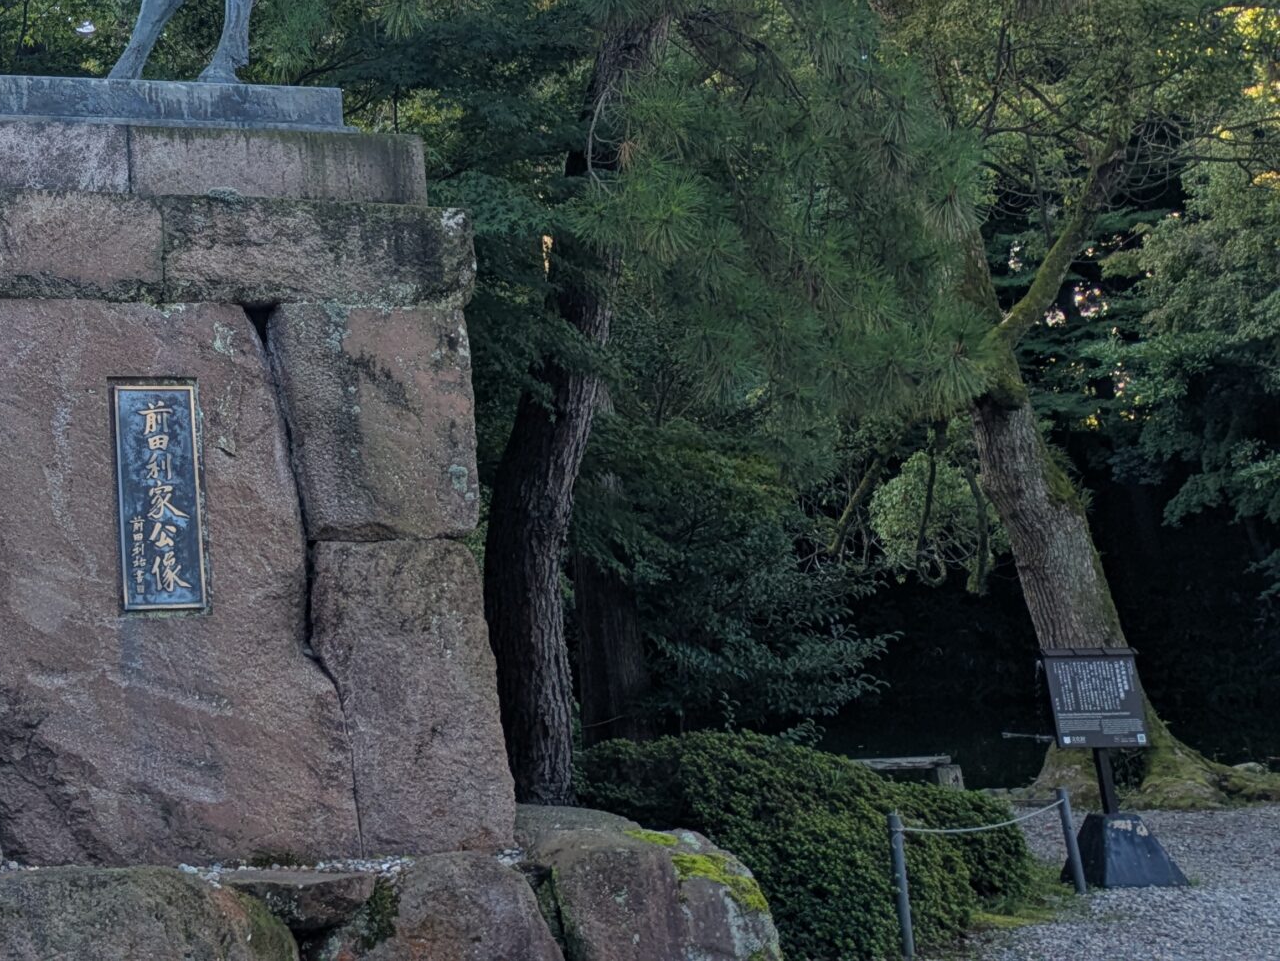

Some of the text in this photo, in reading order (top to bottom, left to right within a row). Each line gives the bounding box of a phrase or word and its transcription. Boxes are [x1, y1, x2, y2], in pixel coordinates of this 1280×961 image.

[137, 401, 191, 592] 前田利家公像
